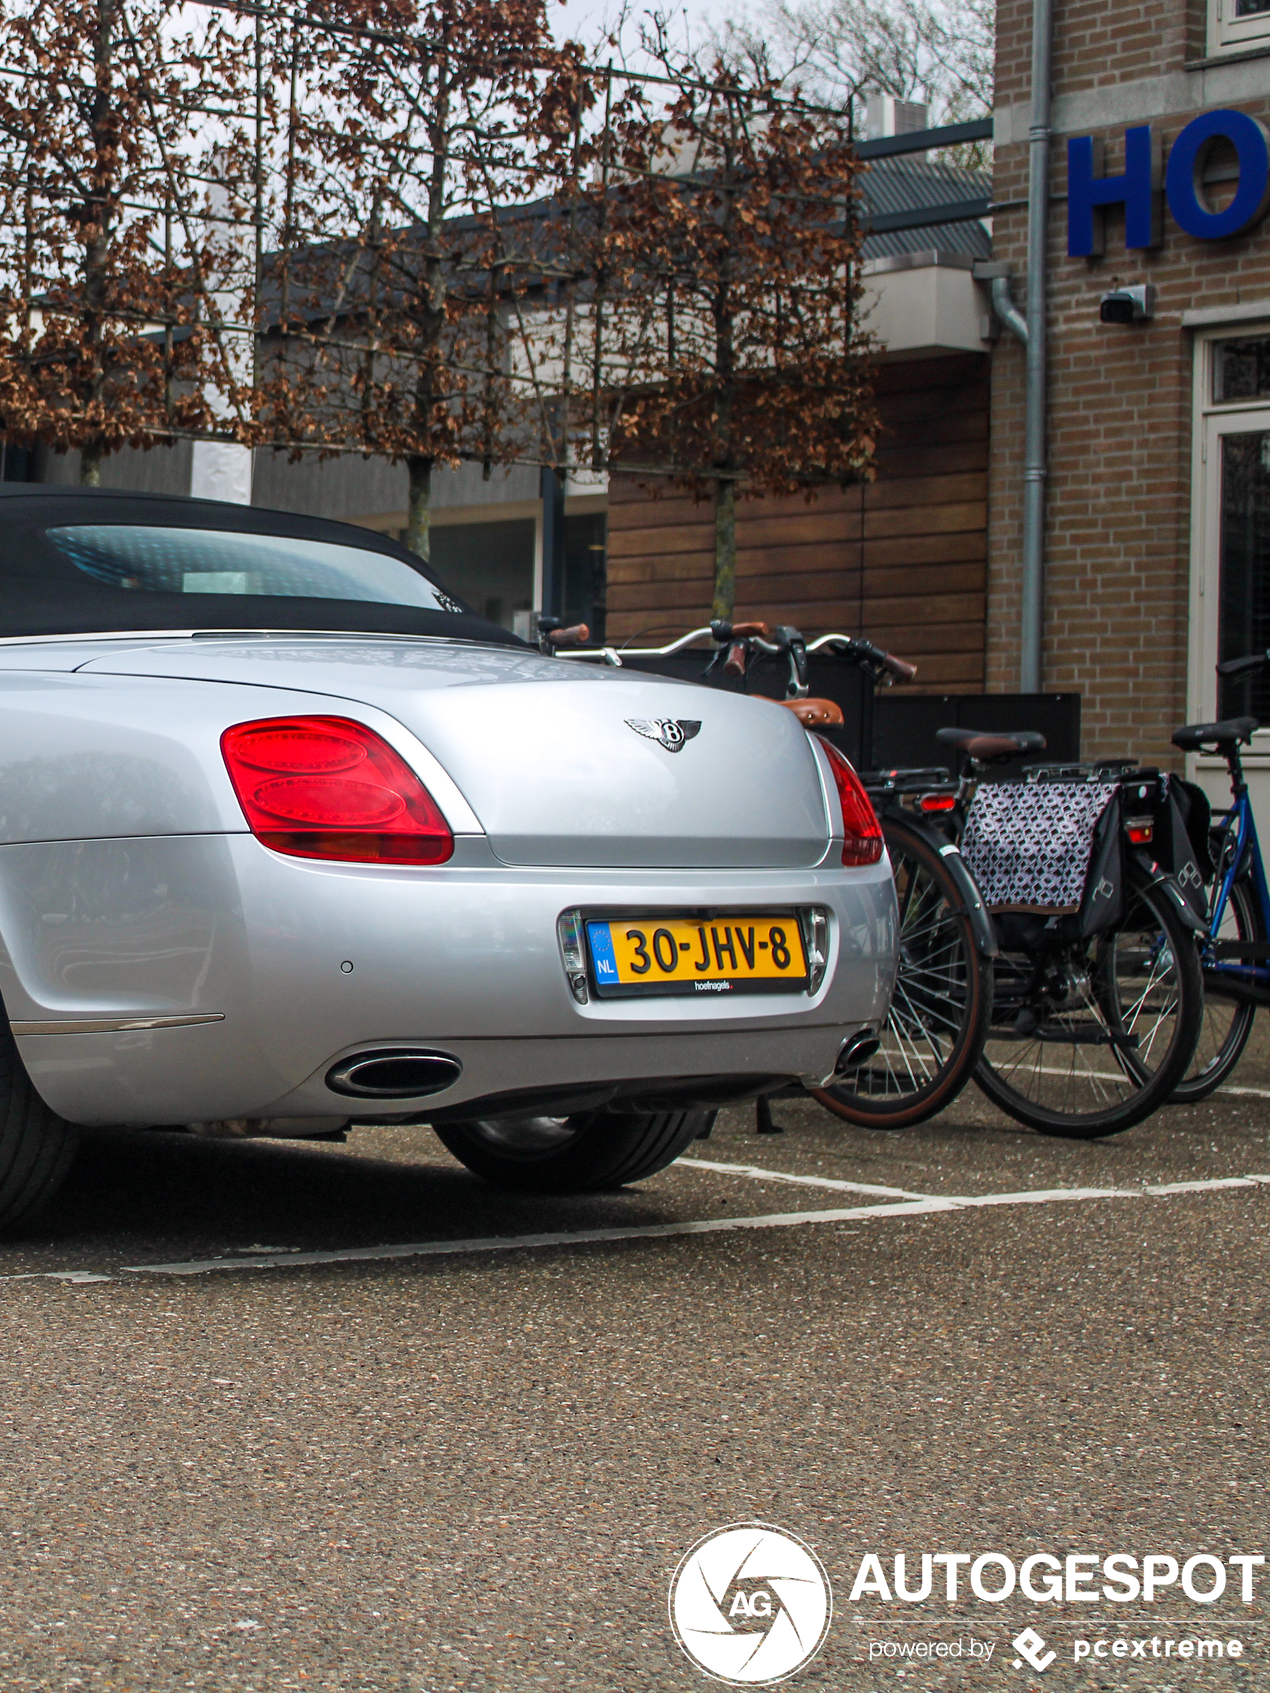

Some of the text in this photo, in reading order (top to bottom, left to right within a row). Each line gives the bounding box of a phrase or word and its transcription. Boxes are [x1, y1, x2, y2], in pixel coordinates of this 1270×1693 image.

[1068, 109, 1269, 258] HO
[597, 960, 615, 974] NL
[626, 926, 791, 975] 30-JHV-8
